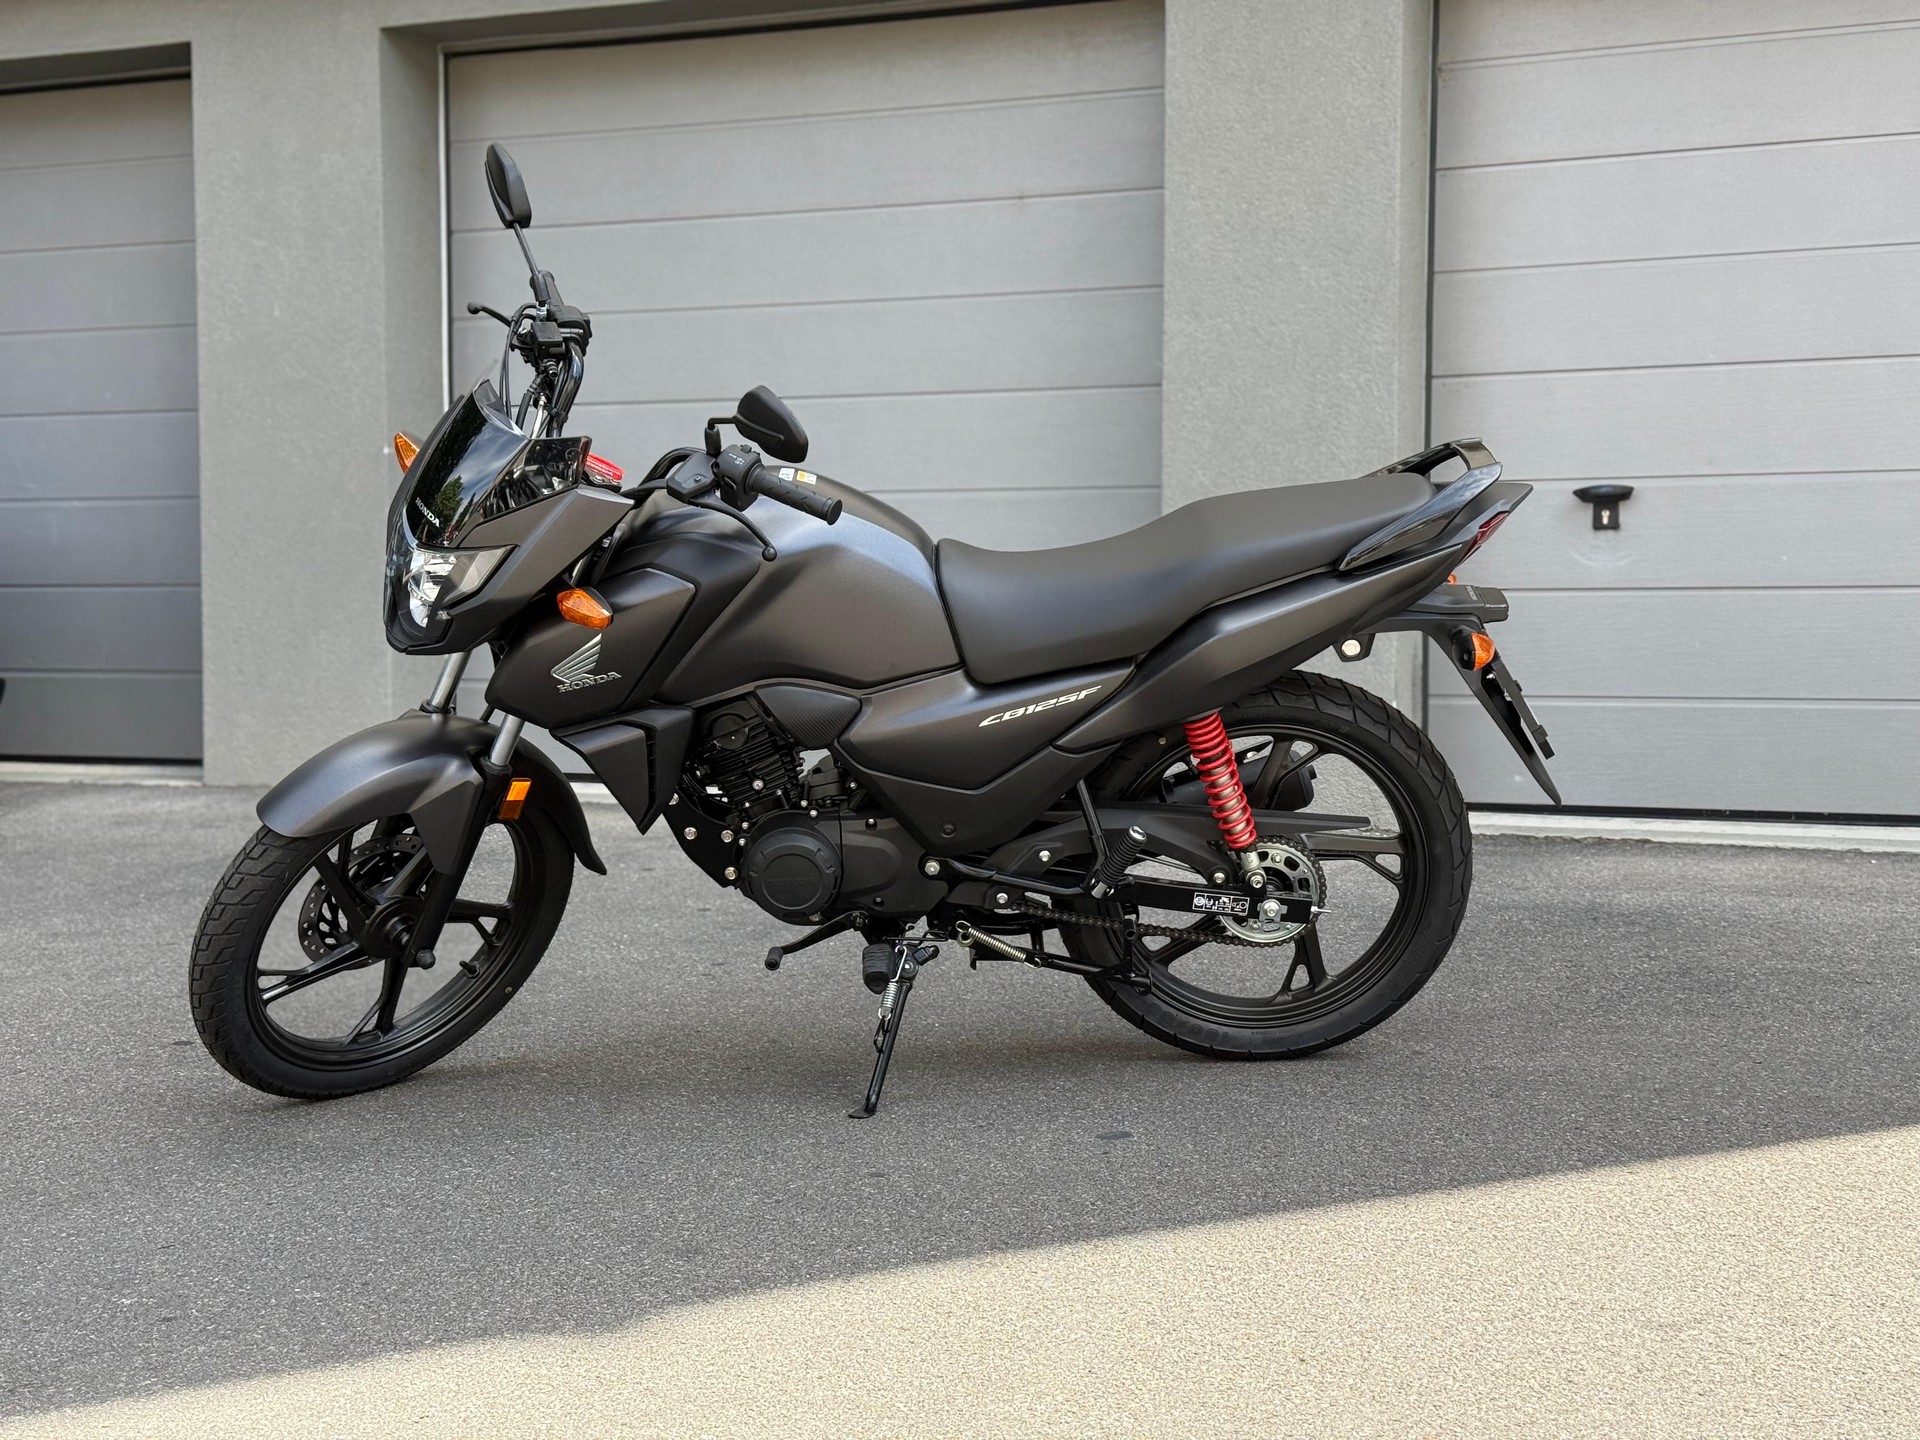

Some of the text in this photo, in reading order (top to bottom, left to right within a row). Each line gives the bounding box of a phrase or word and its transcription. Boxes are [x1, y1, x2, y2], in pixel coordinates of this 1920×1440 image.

[415, 496, 440, 528] HONDA
[556, 671, 622, 693] HONDA
[978, 685, 1102, 728] CB125F
